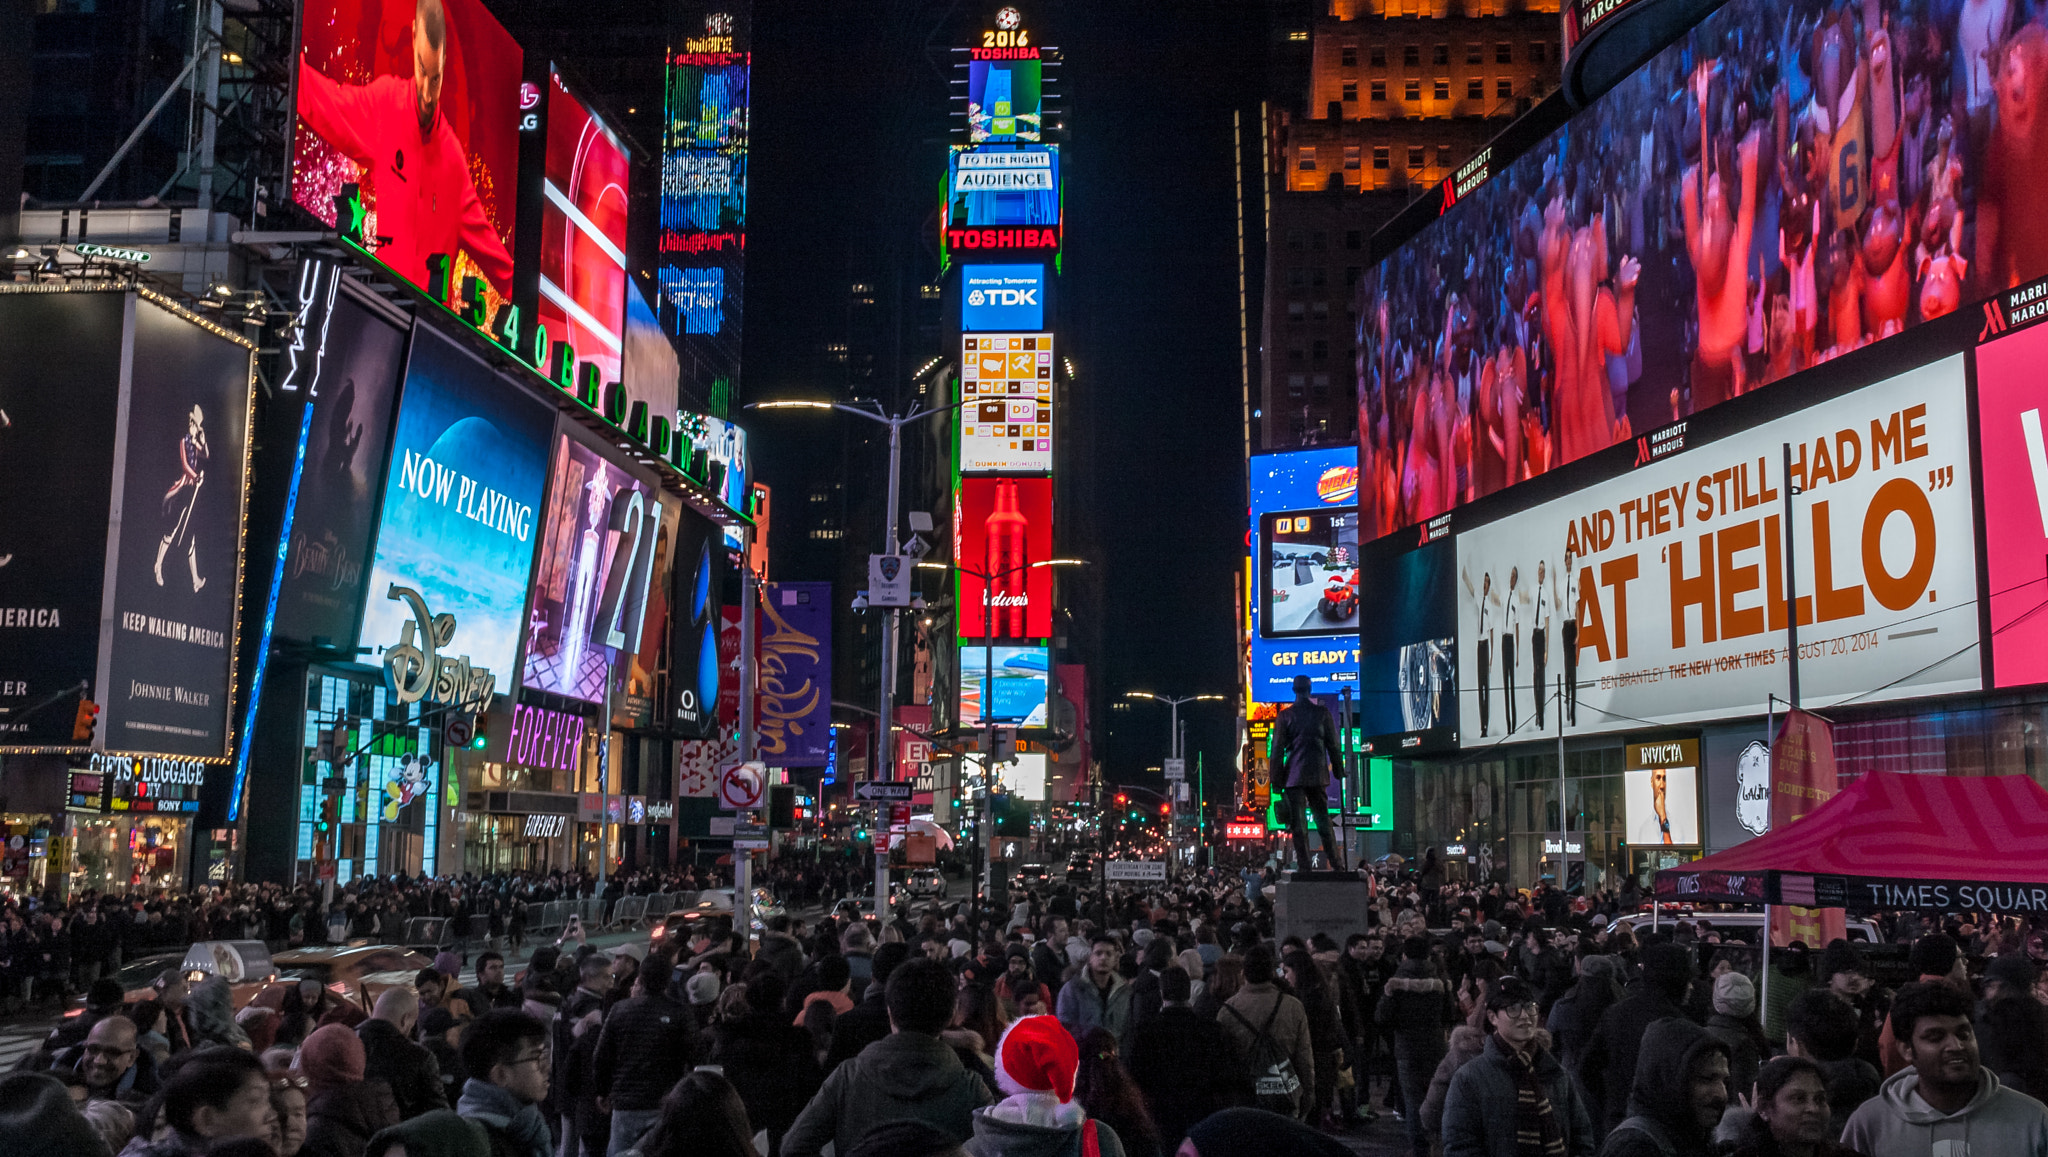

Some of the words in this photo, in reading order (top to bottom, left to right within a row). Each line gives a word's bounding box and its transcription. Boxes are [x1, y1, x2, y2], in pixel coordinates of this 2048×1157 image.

[983, 31, 1029, 47] 2016
[971, 47, 1040, 60] TOSHIBA
[519, 114, 538, 130] G
[965, 154, 979, 165] TO
[985, 154, 1005, 164] THE
[1010, 154, 1045, 164] RIGHT
[1457, 146, 1492, 183] MARRIOTT
[963, 173, 1046, 186] AUDIENCE
[1457, 166, 1488, 198] MARQUIS
[1839, 139, 1859, 212] 6
[949, 230, 1057, 249] TOSHIBA
[82, 245, 145, 261] LAMAR
[969, 278, 1002, 286] Attracting
[1004, 277, 1037, 285] Tomorrow
[984, 289, 1037, 306] TDK
[2011, 282, 2048, 307] MARRI
[426, 253, 548, 369] 1540
[2011, 299, 2048, 325] MARQ
[1652, 421, 1687, 444] MARRIOTT
[1652, 437, 1684, 457] MARQUIS
[1566, 510, 1615, 559] AND
[1620, 481, 1690, 544] THEY
[1695, 455, 1778, 522] STILL
[1791, 428, 1862, 492] HAD
[1870, 402, 1929, 471] ME
[399, 447, 457, 507] NOW
[456, 475, 532, 542] PLAYING
[1330, 517, 1345, 527] 1st
[606, 488, 663, 655] 21
[1576, 553, 1639, 667] AT
[122, 610, 146, 633] KEEP
[148, 616, 187, 641] WALKING
[188, 625, 224, 649] AMERICA
[1272, 652, 1299, 666] GET
[1303, 650, 1348, 665] READY
[1781, 639, 1827, 663] AGUST
[1830, 635, 1850, 657] 20,
[1851, 631, 1880, 651] 2014
[1669, 664, 1687, 680] THE
[1689, 660, 1712, 676] NEW
[1713, 653, 1743, 673] YORK
[1744, 648, 1777, 669] TIMES
[1601, 675, 1618, 690] BEN
[1619, 666, 1665, 688] BRANTLEY
[129, 679, 172, 701] JOHNNIE
[174, 686, 210, 707] WALKER
[678, 708, 697, 722] OAKLEY
[506, 703, 584, 771] FOREVER
[1640, 743, 1683, 765] INVICTA
[142, 757, 205, 786] LUGGAGE
[872, 787, 888, 795] ONE
[890, 787, 906, 795] WAY
[523, 814, 556, 837] FOREVER
[554, 815, 566, 837] 21
[1677, 874, 1700, 895] TIMES
[1727, 875, 1746, 896] NYC
[1867, 884, 1950, 908] TIMES
[1959, 886, 2048, 913] SQUAR
